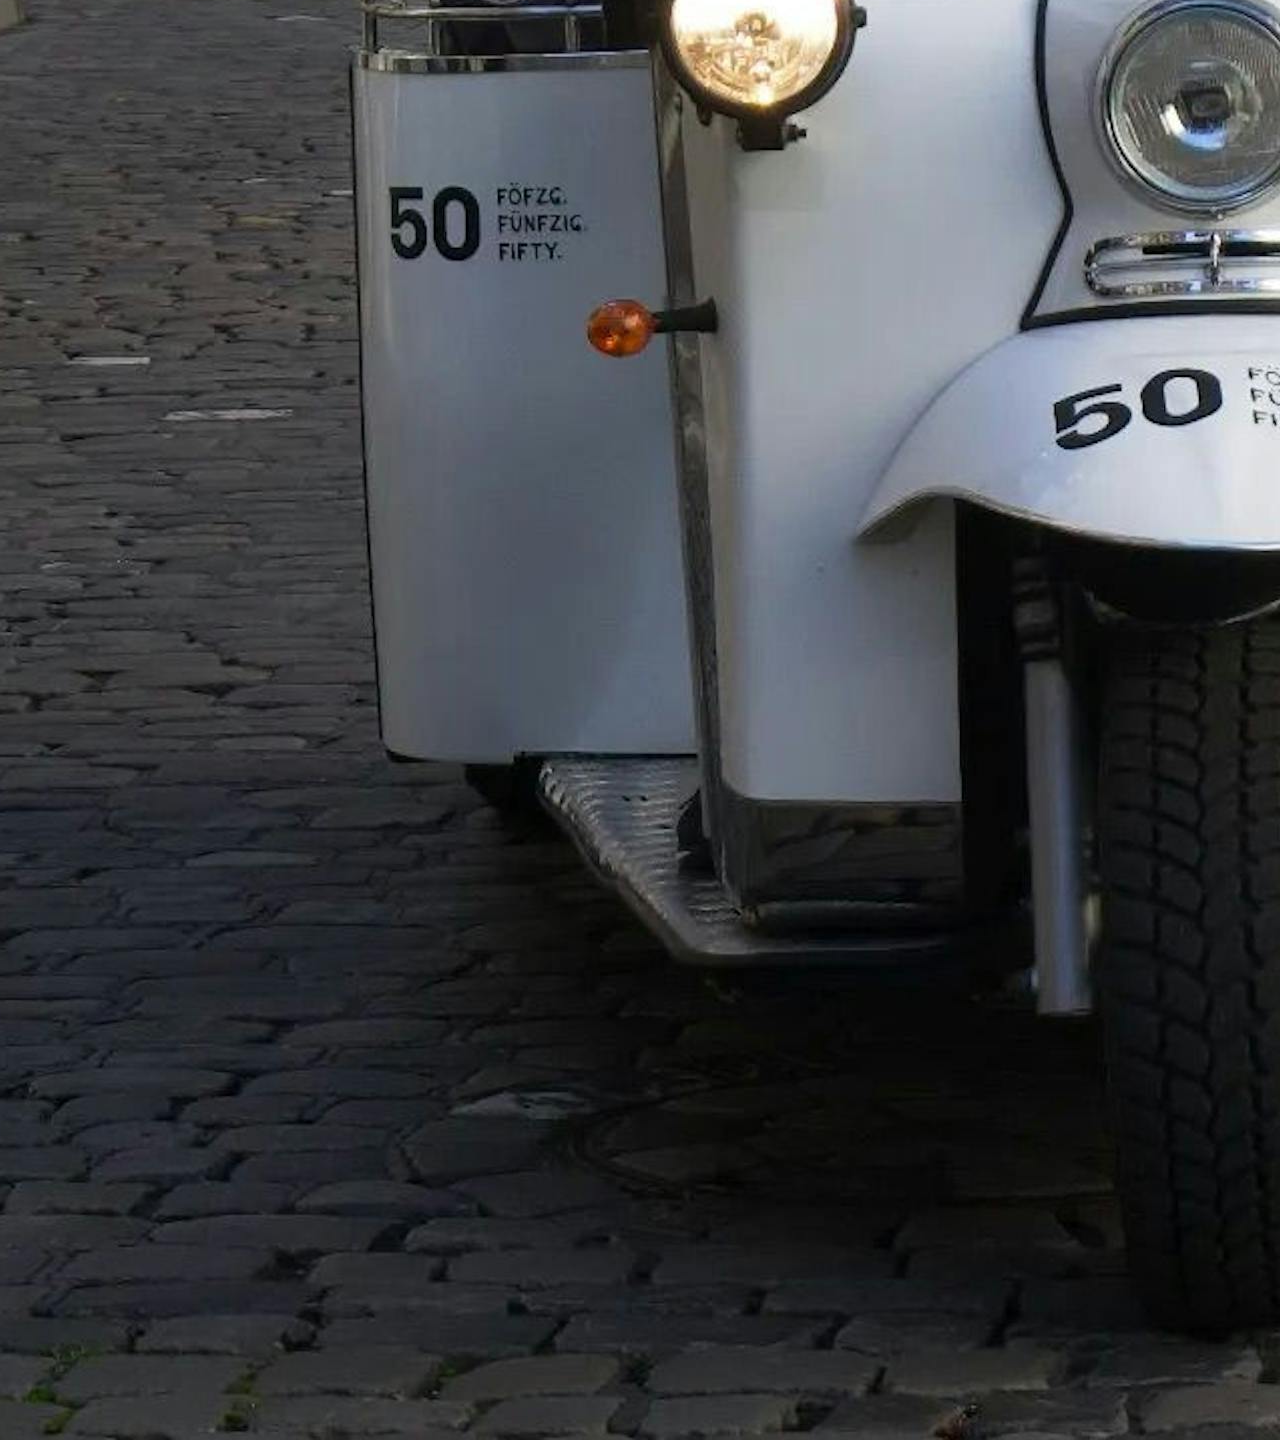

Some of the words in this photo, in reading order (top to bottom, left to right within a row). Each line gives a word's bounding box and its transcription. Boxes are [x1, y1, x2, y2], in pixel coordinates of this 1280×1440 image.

[497, 182, 568, 206] FÖFZG.
[389, 186, 480, 260] 50
[499, 241, 563, 260] FIFTY.
[1053, 368, 1222, 450] 50
